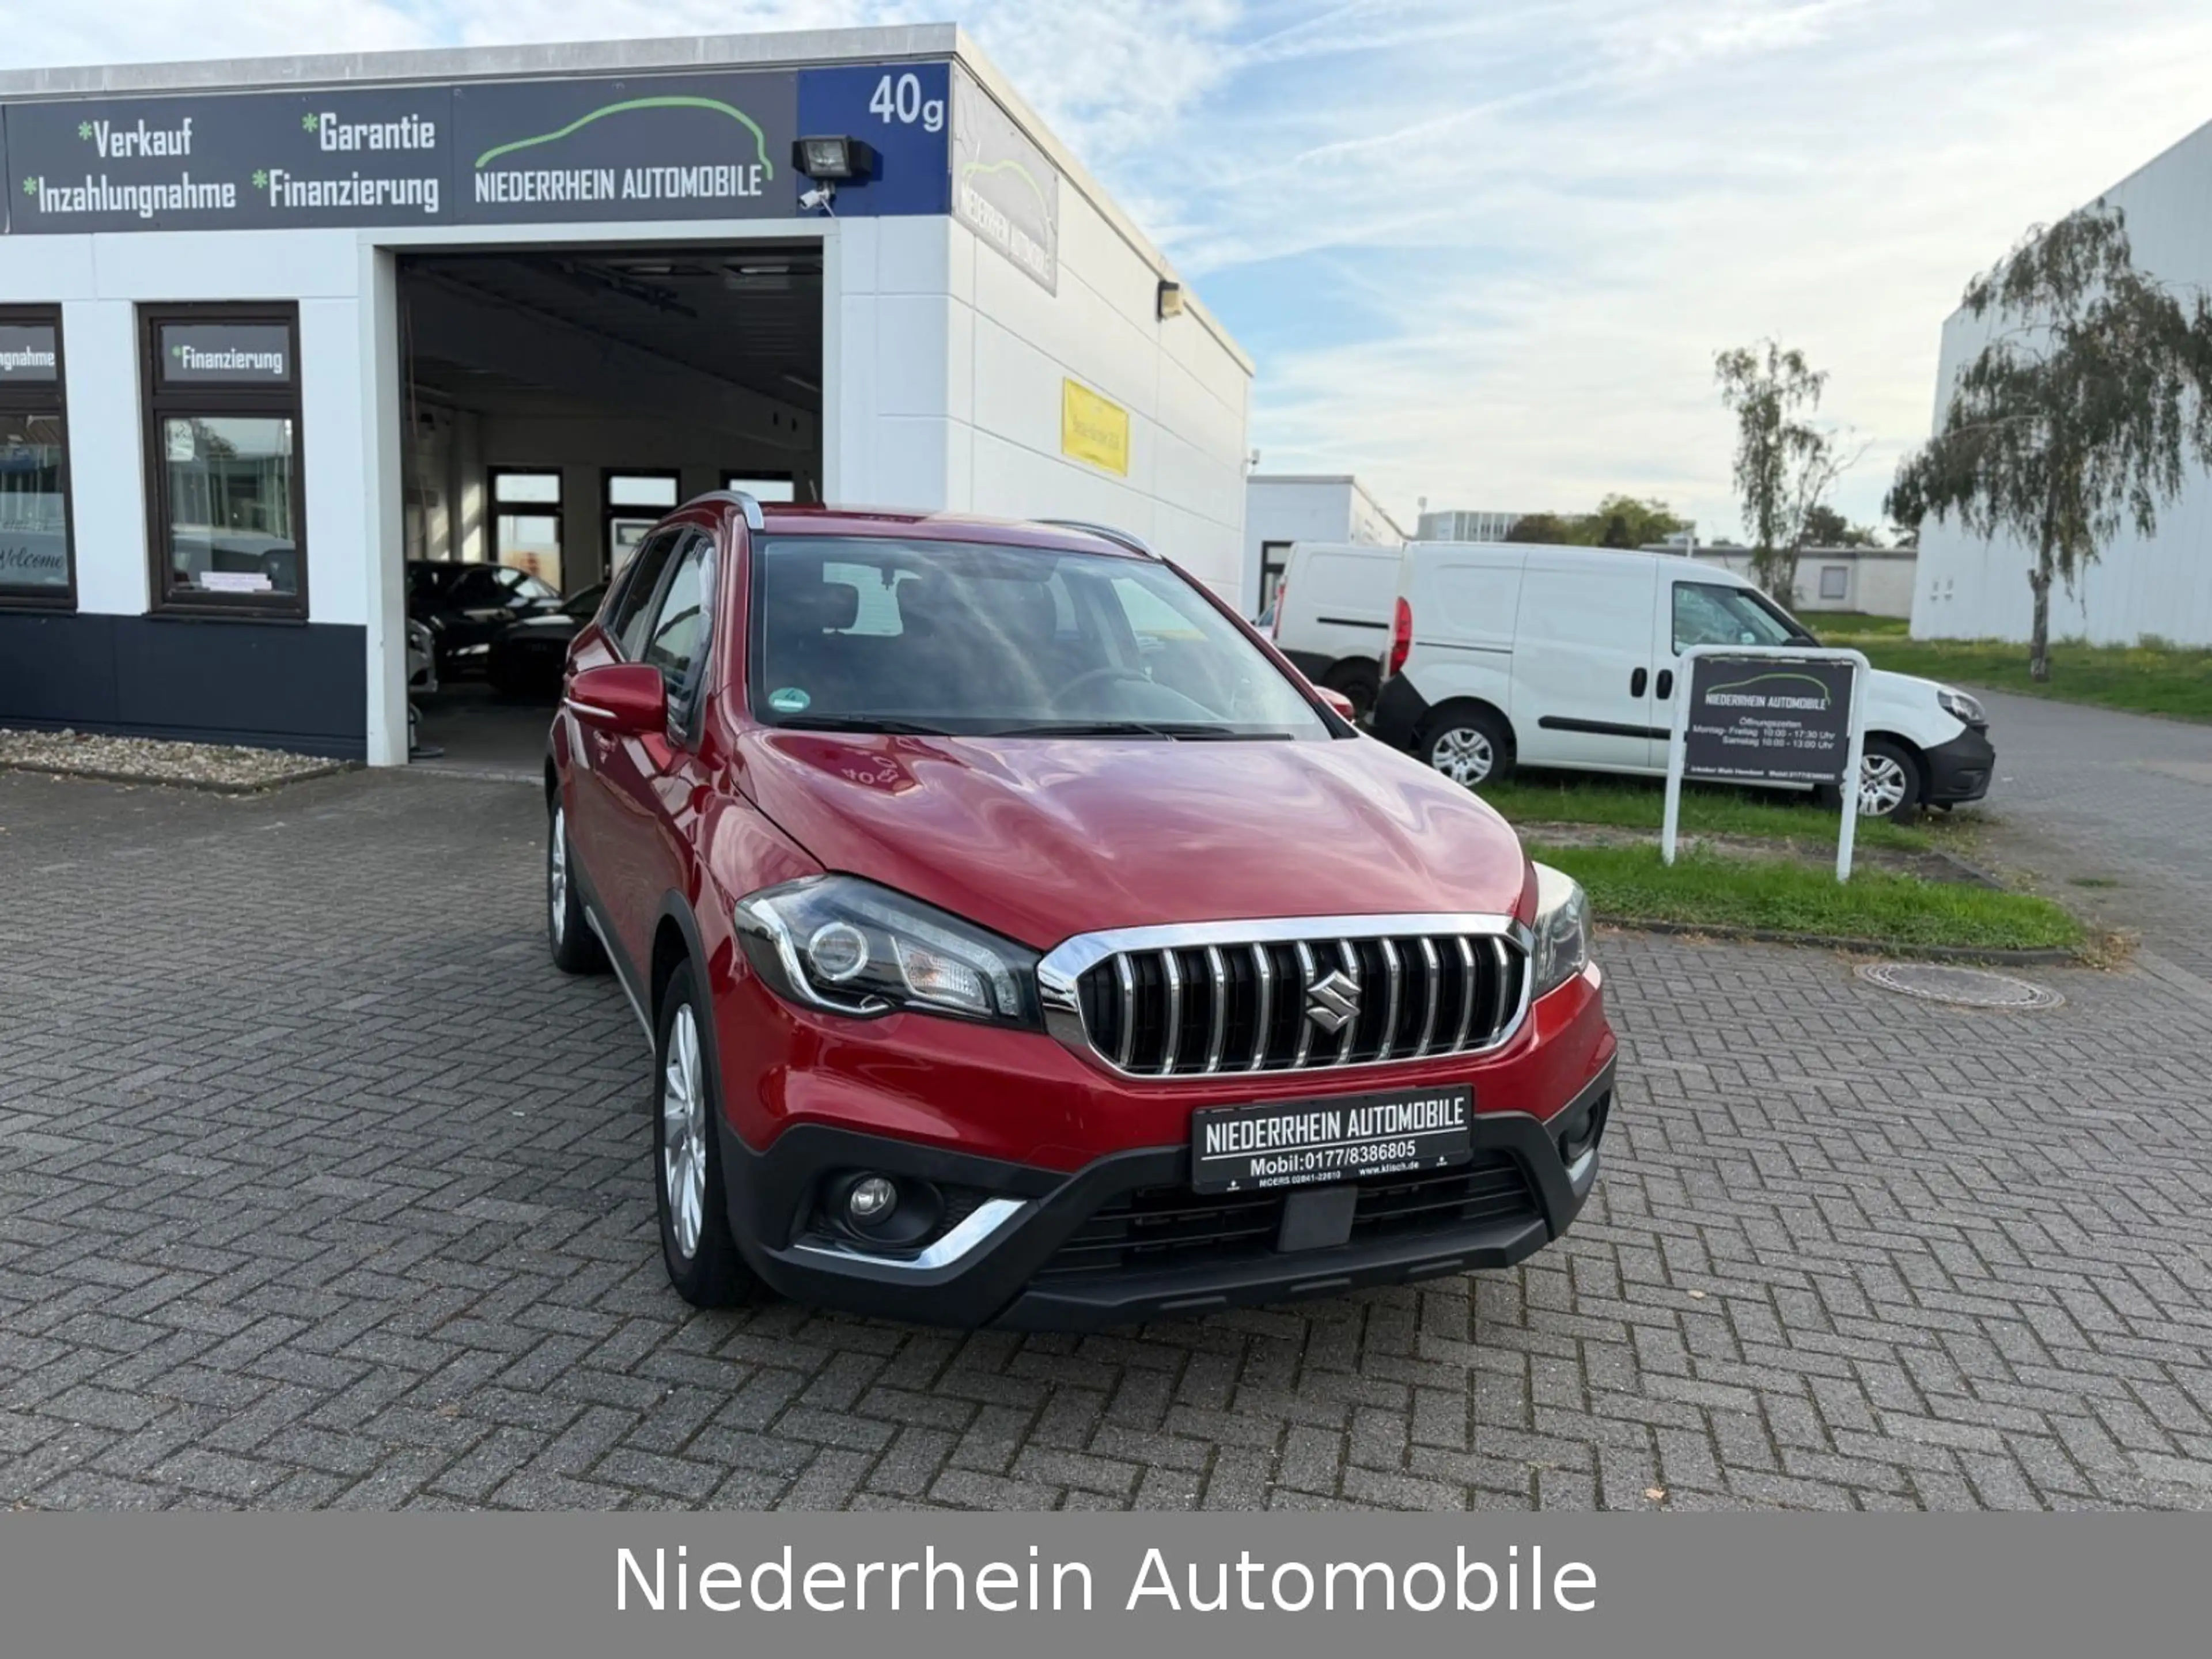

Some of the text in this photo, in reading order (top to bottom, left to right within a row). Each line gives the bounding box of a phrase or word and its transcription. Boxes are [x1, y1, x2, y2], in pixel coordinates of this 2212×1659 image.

[869, 73, 944, 132] 40g
[475, 164, 762, 203] NIEDERRHEIN AUTOMOBILE
[1705, 693, 1826, 711] NIEDERRHEIN AUTOMOBILE
[1818, 741, 1835, 750] Uhr
[1819, 731, 1836, 740] Uhr
[1206, 1097, 1464, 1153] NIEDERRHEIN AUTOMOBILE
[1251, 1139, 1416, 1176] Mobil:0177/8386805
